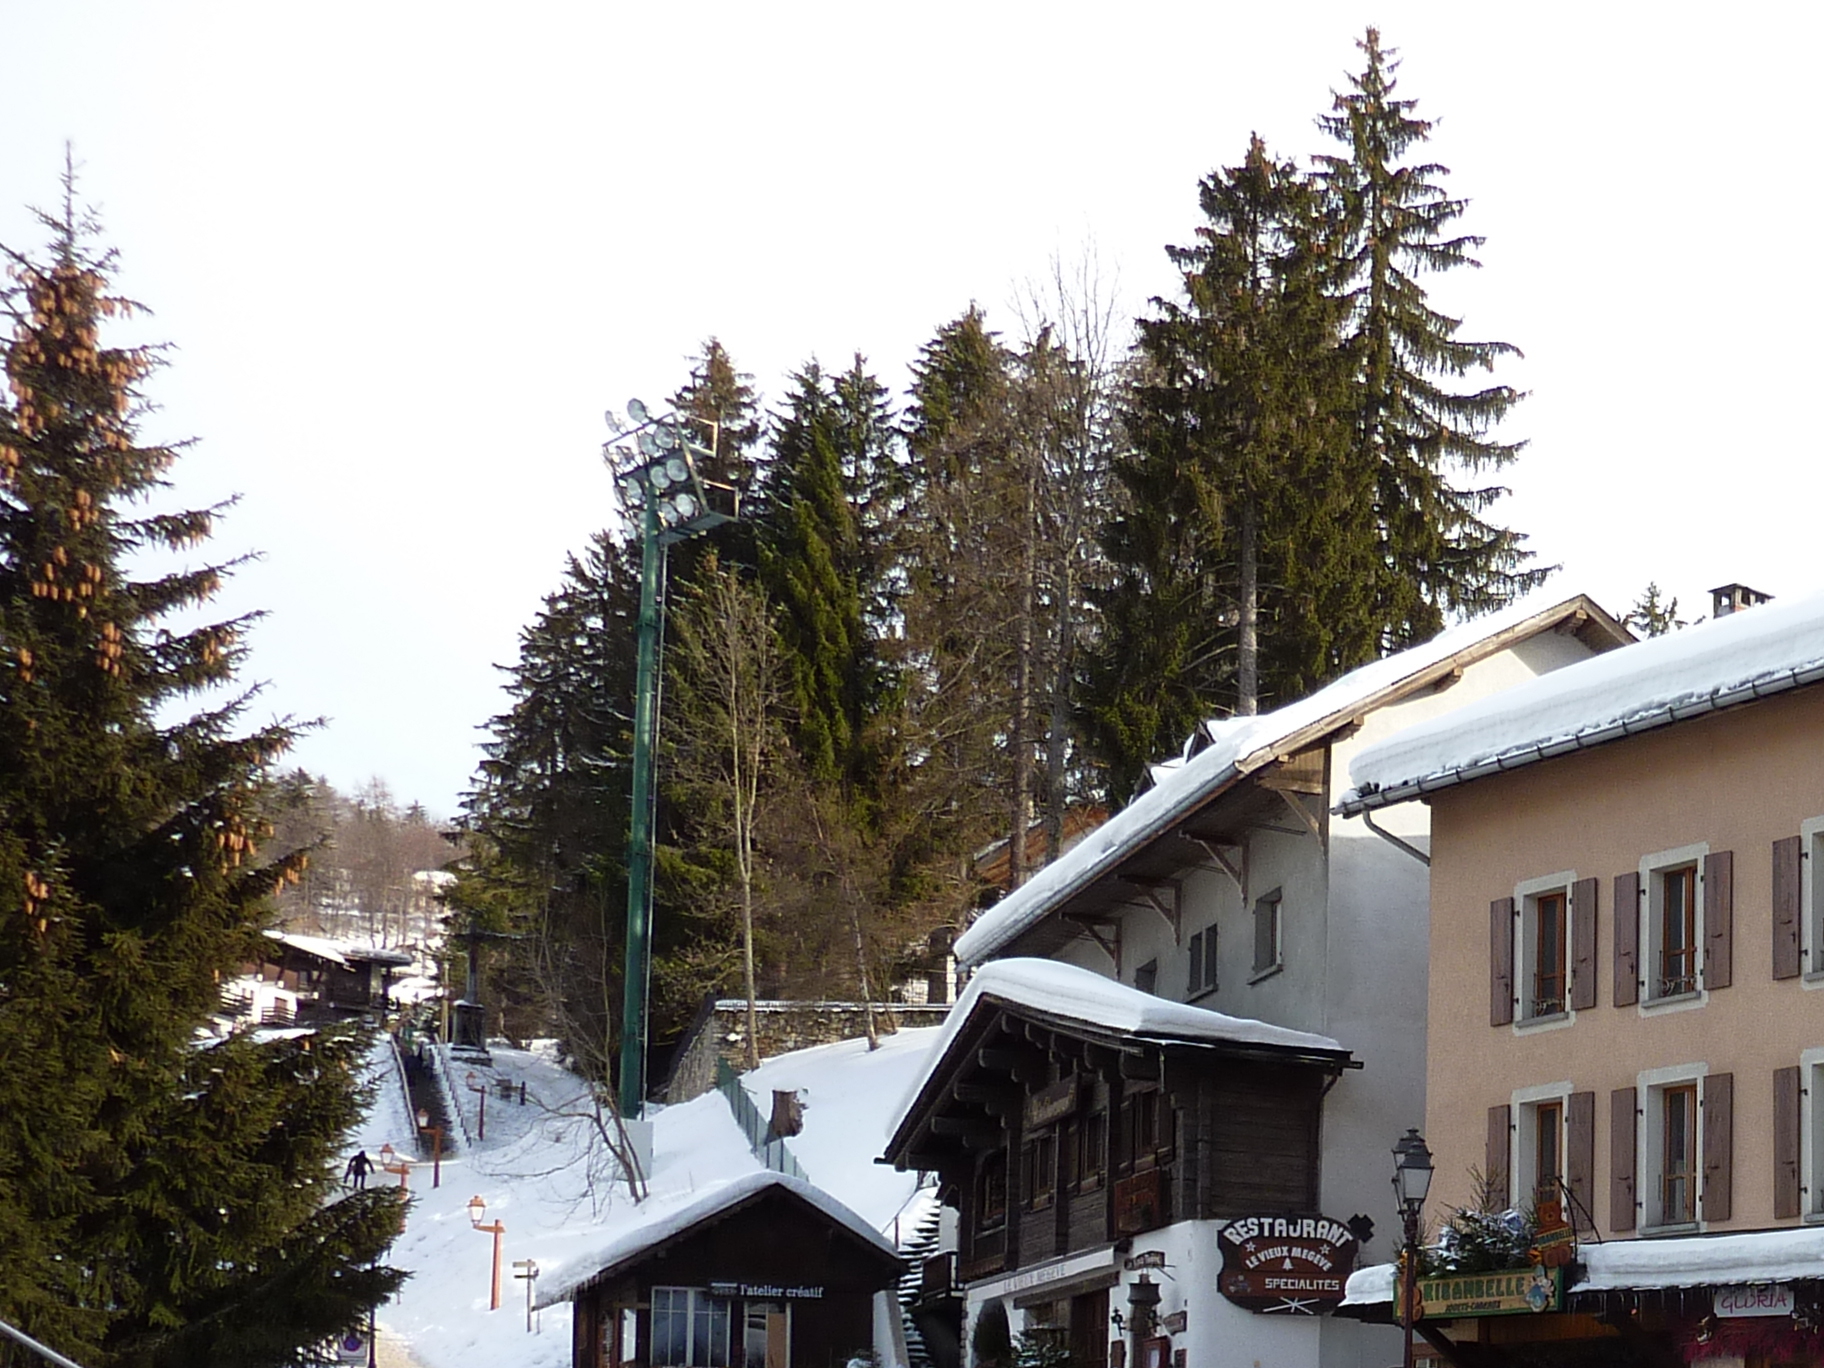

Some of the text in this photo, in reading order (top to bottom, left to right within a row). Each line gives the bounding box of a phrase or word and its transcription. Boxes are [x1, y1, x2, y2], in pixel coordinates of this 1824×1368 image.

[1223, 1217, 1353, 1248] RESTAURANT
[1245, 1255, 1259, 1269] LE
[1257, 1246, 1289, 1262] VIEUX
[740, 1284, 783, 1298] l'atelier
[785, 1286, 824, 1299] créatif
[1720, 1292, 1788, 1314] GLORIA
